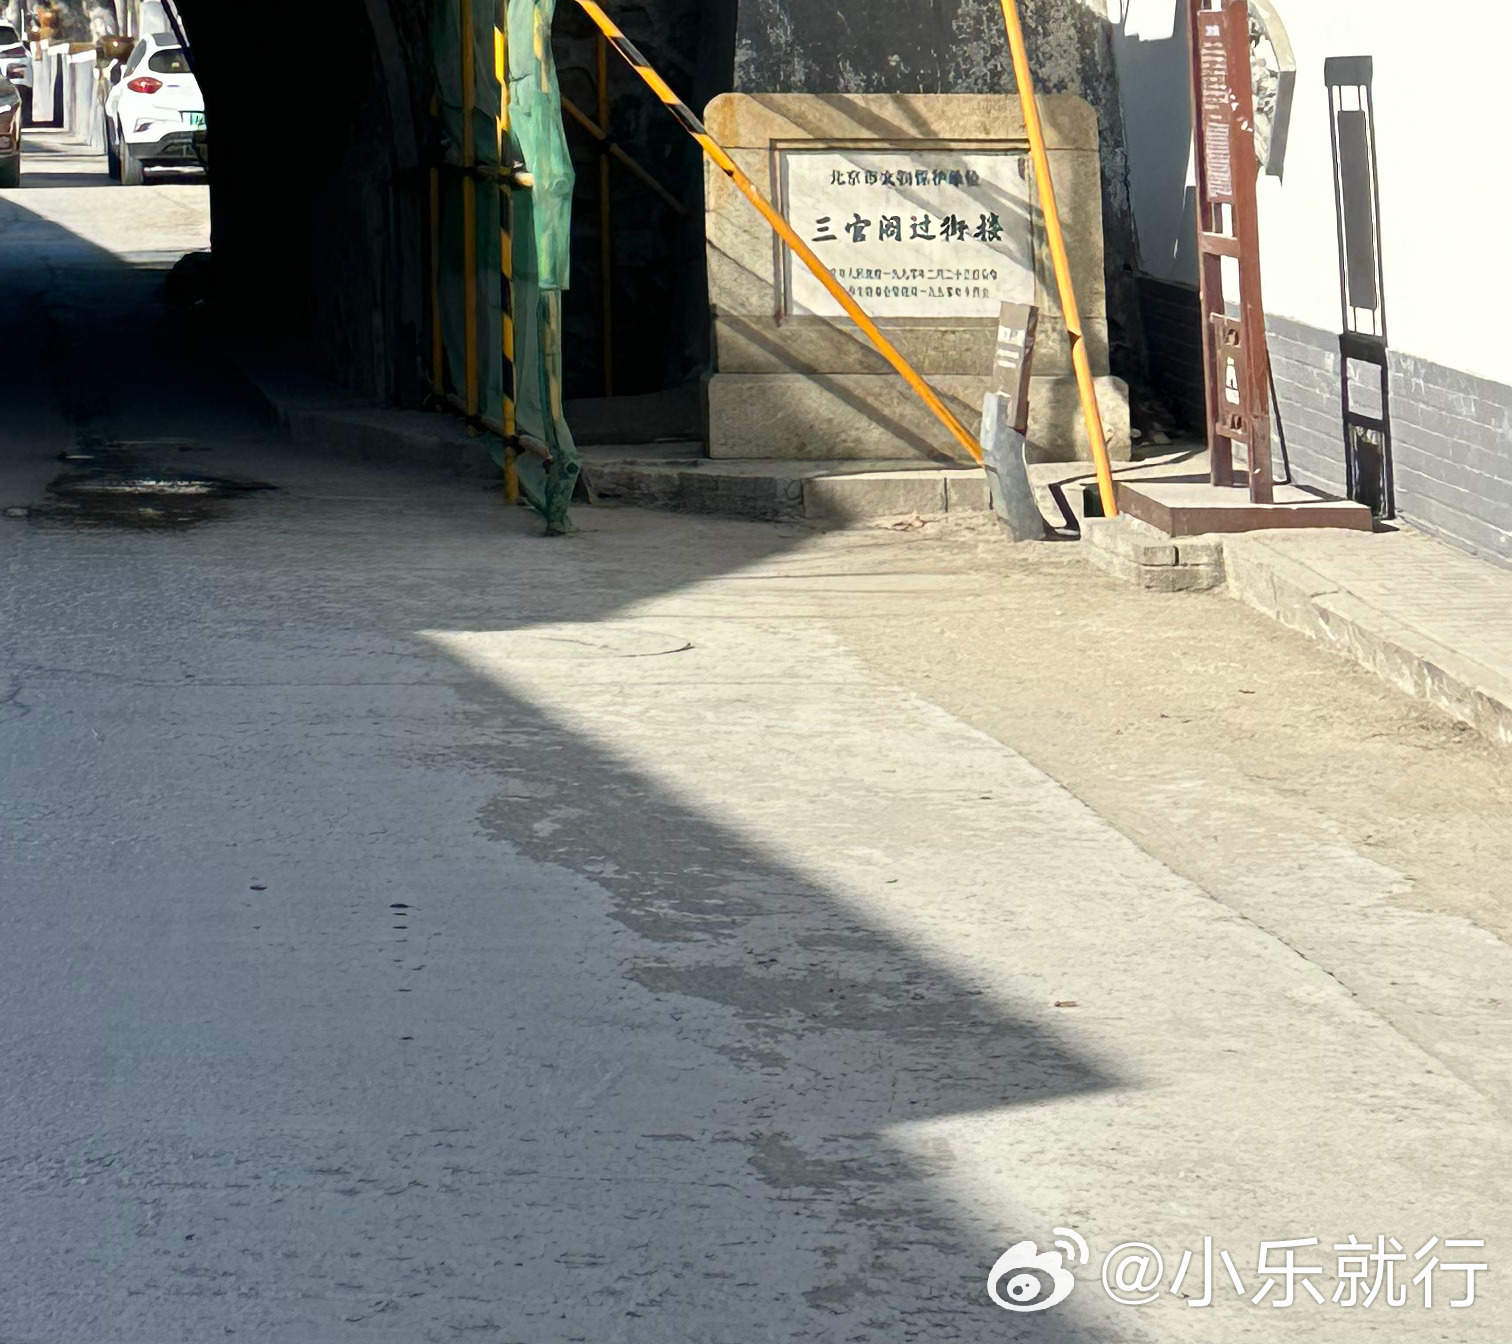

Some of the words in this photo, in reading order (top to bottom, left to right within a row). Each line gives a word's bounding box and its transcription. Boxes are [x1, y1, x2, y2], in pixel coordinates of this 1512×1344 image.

[811, 212, 1005, 242] 三官阁过街楼
